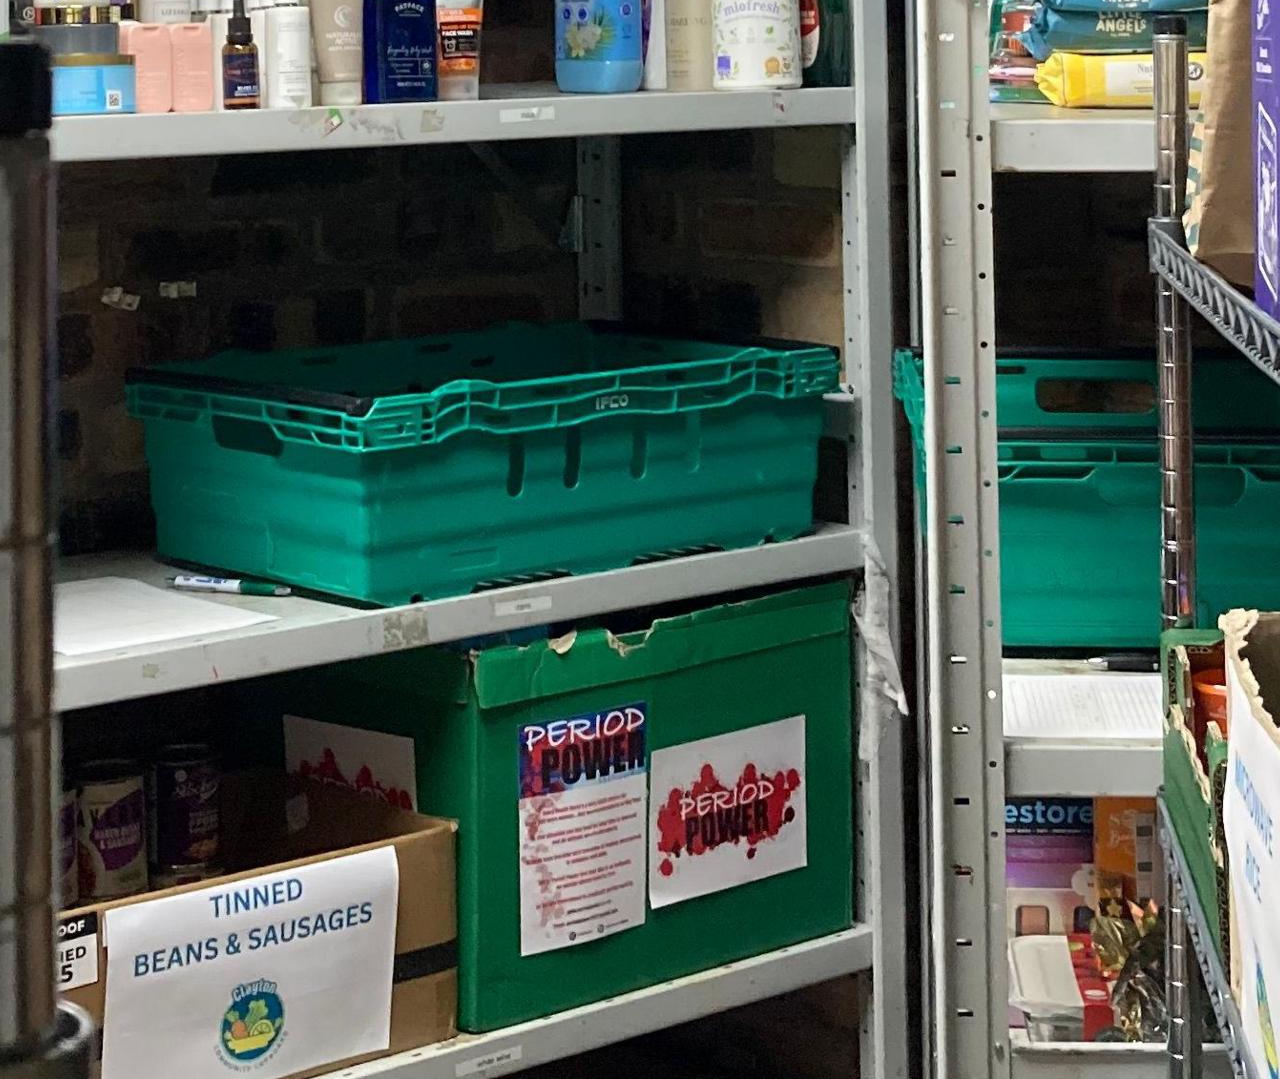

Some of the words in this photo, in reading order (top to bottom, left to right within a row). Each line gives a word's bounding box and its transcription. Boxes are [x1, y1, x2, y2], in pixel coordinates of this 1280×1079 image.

[1095, 18, 1147, 34] ANGELS
[524, 708, 645, 751] PERIOD
[540, 736, 645, 790] POWER
[679, 780, 775, 819] PERIOD
[1005, 799, 1094, 825] estore
[685, 800, 768, 855] POWER
[209, 878, 303, 919] TINNED
[134, 936, 218, 977] BEANS
[225, 933, 241, 956] &
[248, 901, 373, 952] SAUSAGES
